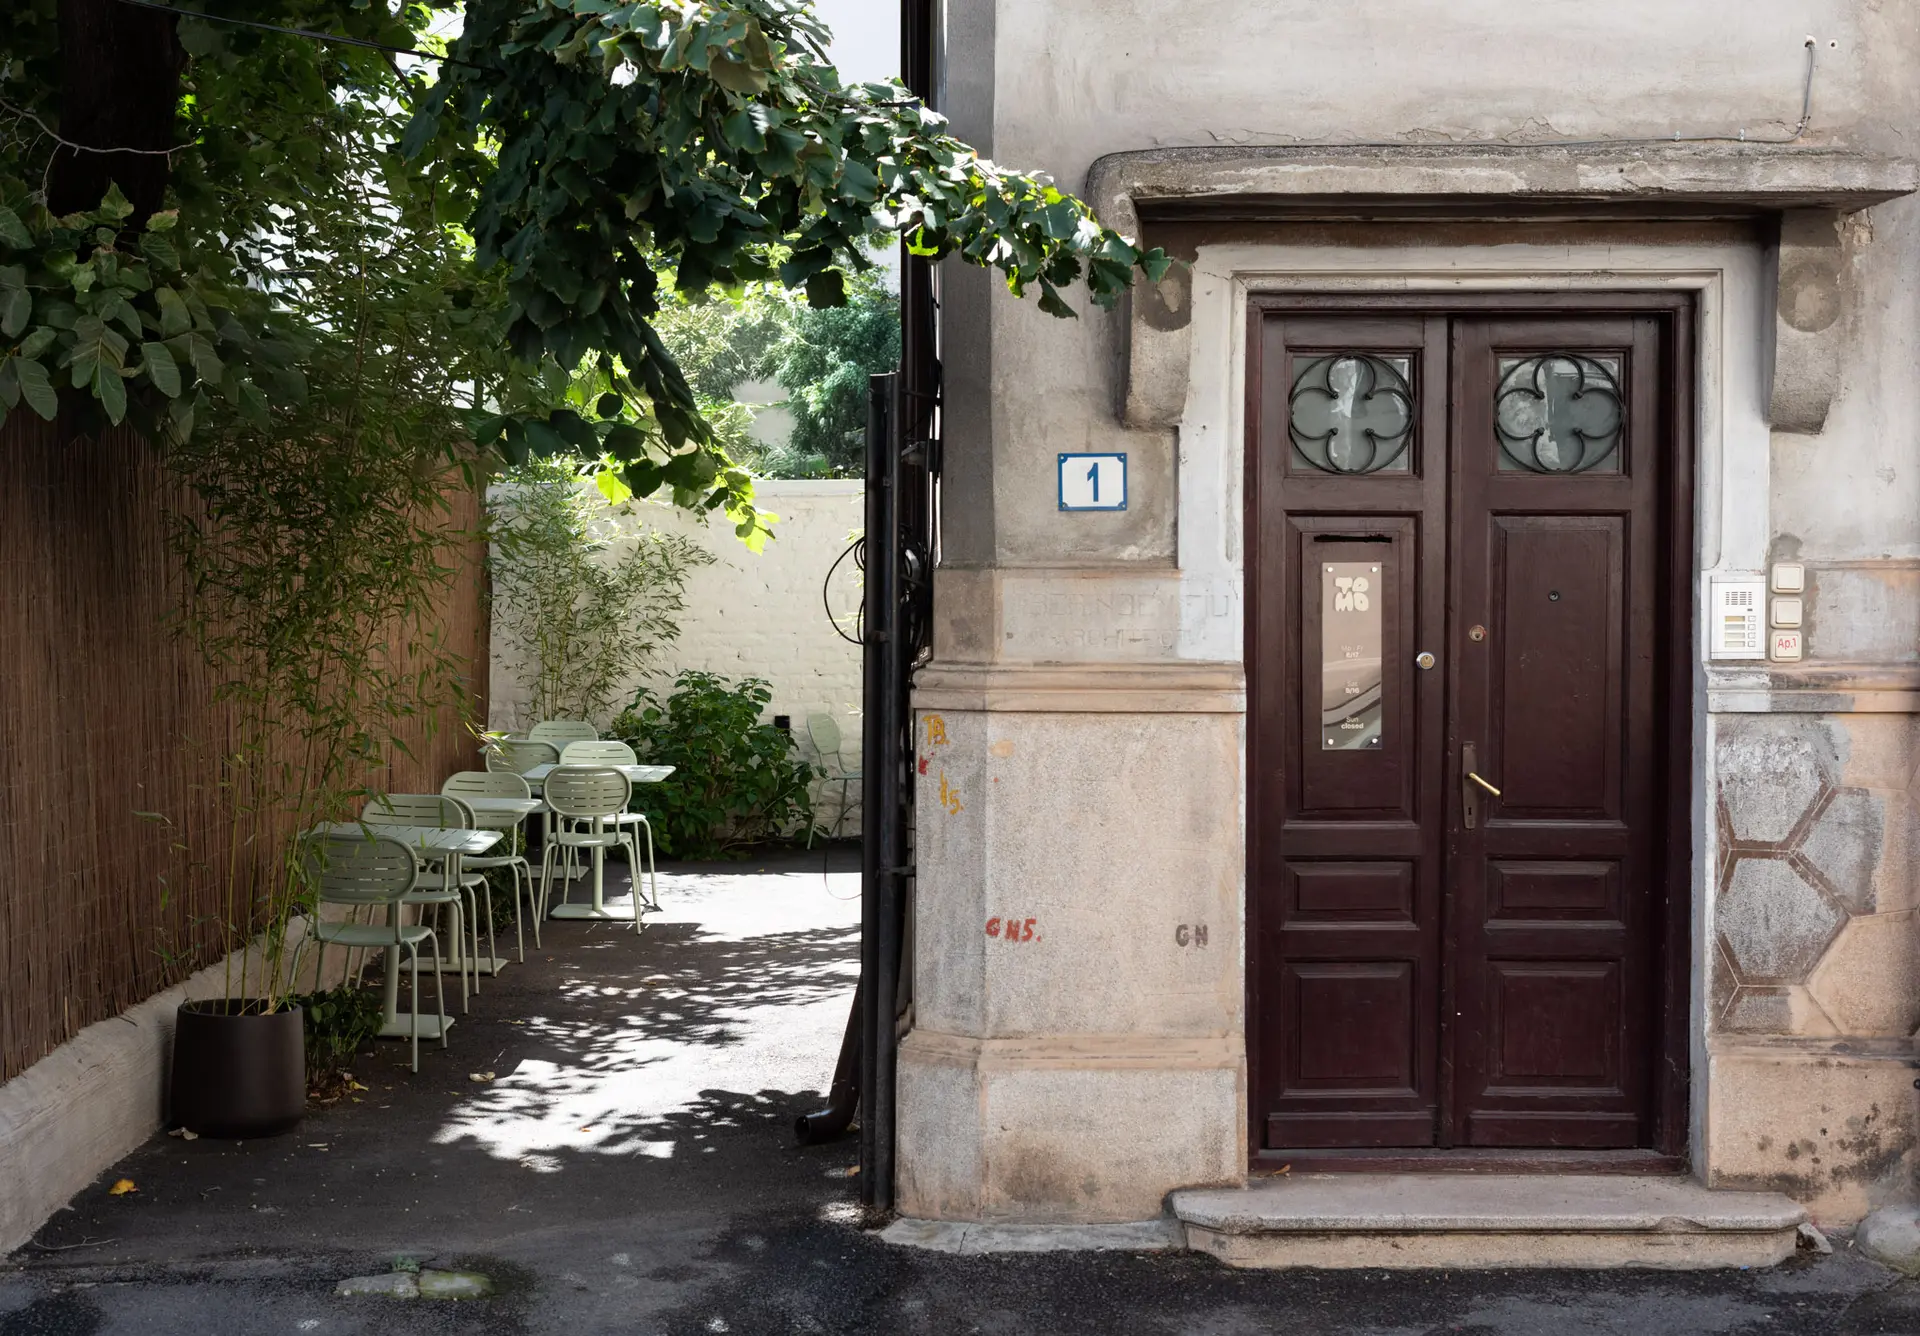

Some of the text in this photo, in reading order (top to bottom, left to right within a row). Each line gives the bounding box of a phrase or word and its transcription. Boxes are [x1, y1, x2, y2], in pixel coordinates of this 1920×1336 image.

[1087, 462, 1099, 502] 1
[1335, 577, 1369, 594] TO
[1335, 591, 1369, 612] MO
[1777, 637, 1797, 650] Ap.1
